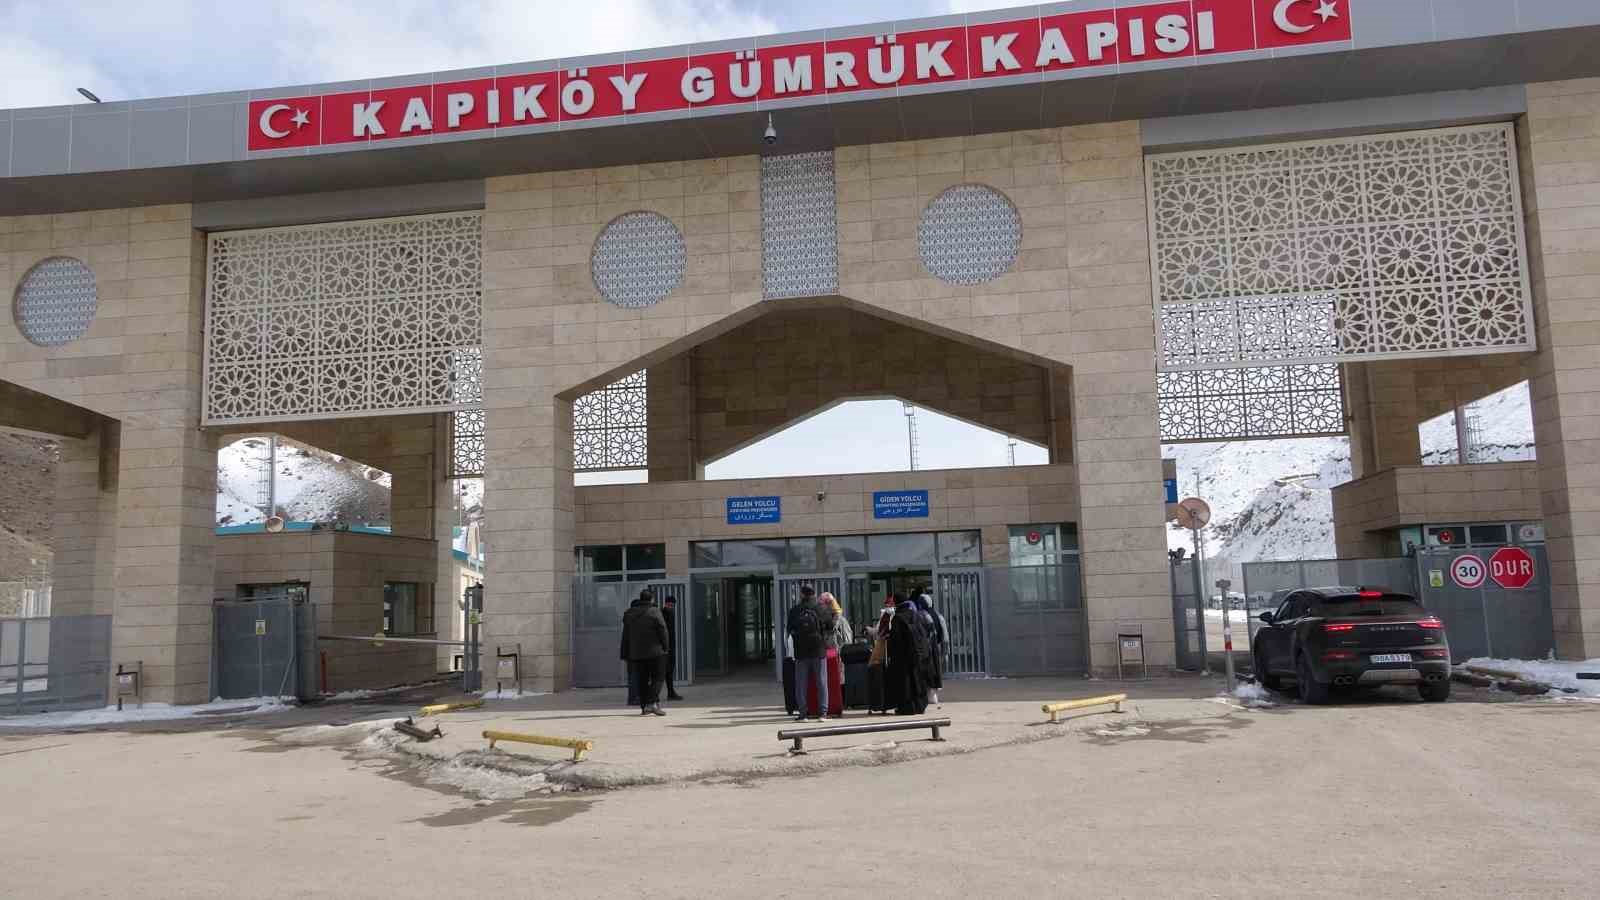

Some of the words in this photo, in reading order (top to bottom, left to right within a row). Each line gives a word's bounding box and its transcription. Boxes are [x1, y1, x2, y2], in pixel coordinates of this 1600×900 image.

[352, 67, 648, 137] KAPIKÖY
[680, 35, 955, 106] GÜMRÜK
[980, 10, 1215, 73] KAPISI
[1458, 566, 1478, 577] 30
[1493, 559, 1531, 577] DUR
